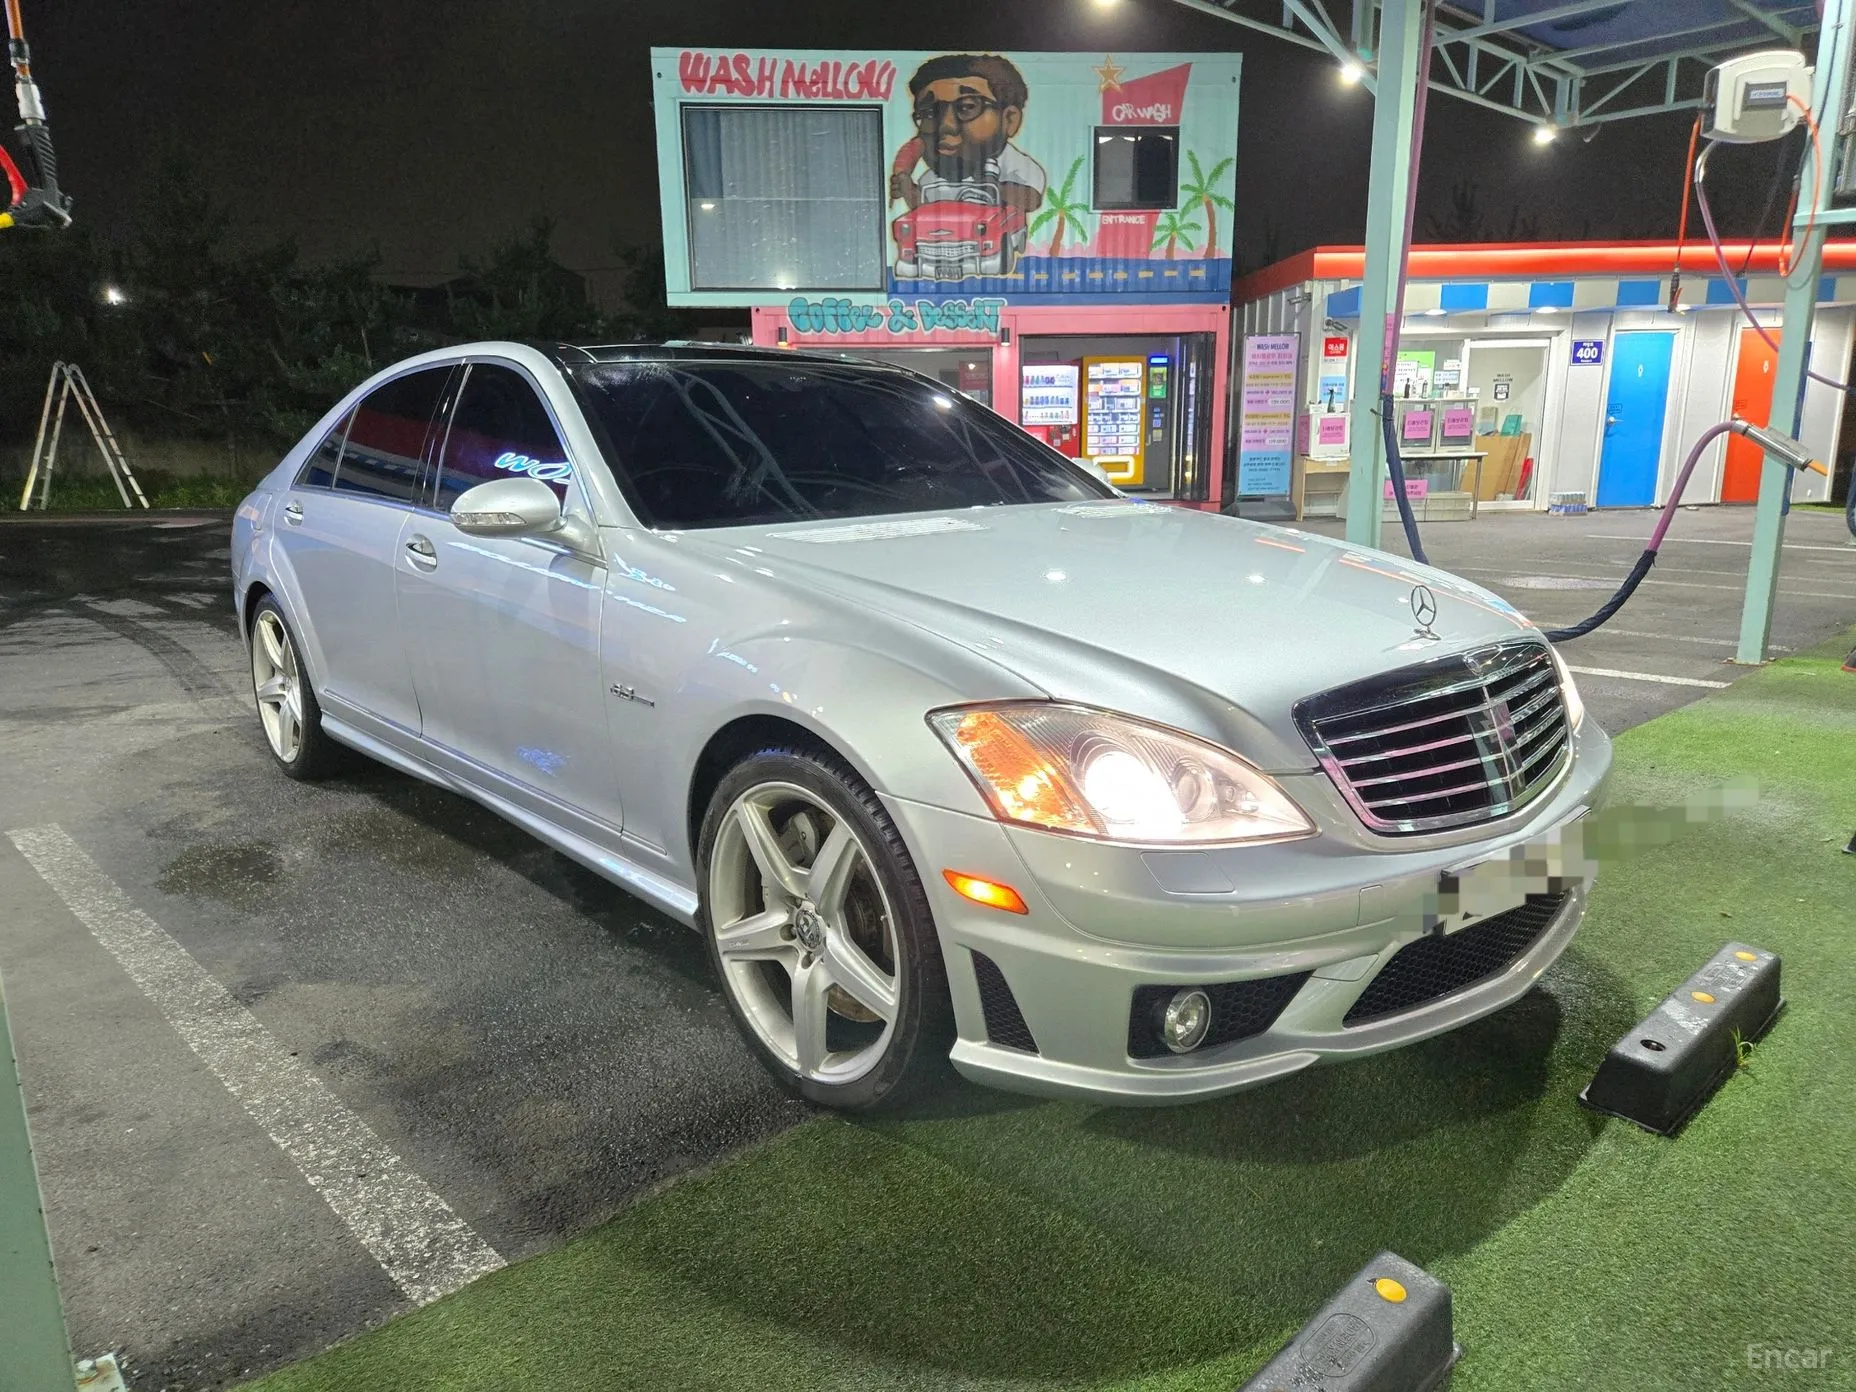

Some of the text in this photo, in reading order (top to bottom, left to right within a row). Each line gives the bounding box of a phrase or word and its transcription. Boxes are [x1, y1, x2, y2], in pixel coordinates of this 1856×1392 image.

[679, 51, 778, 98] WASH
[1101, 214, 1146, 225] ENTRANCE
[1576, 347, 1599, 359] 400
